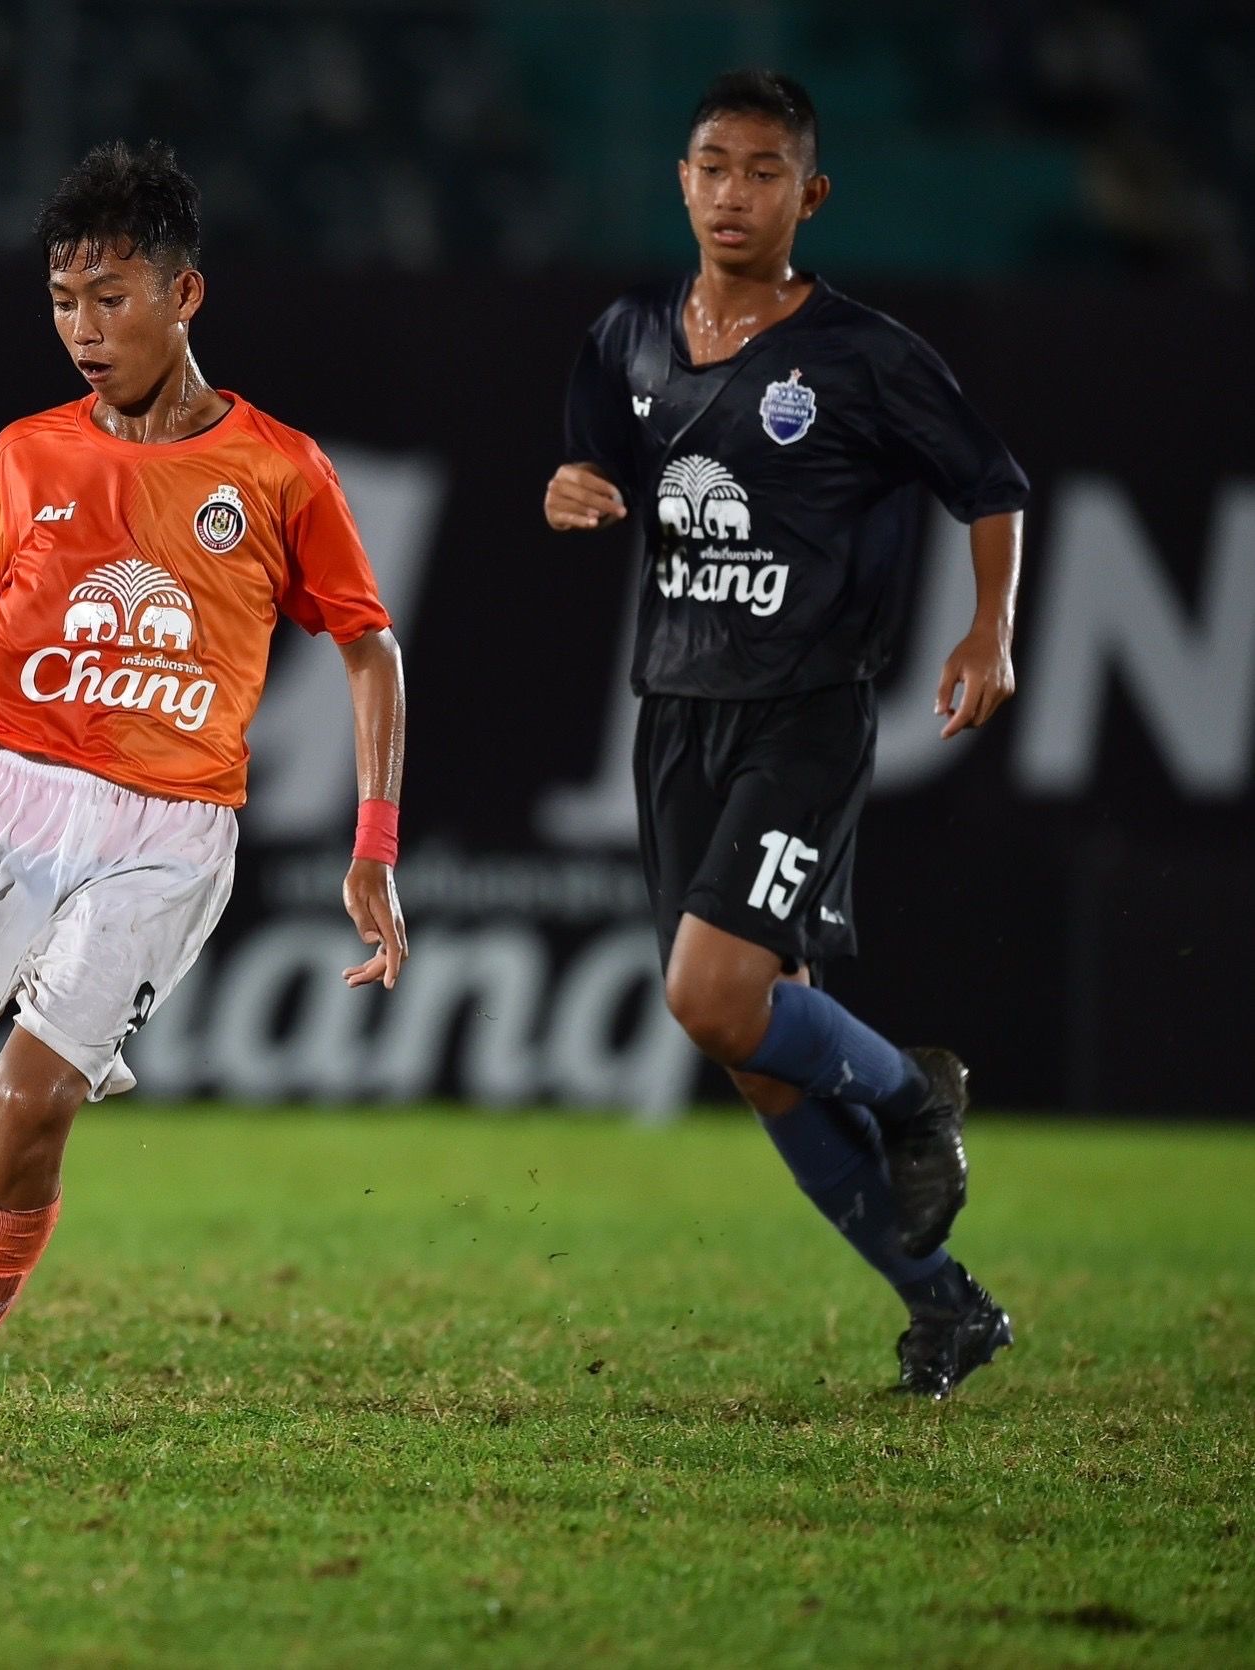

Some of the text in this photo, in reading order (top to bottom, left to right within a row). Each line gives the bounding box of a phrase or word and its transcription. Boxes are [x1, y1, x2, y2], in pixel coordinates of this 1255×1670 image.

[33, 501, 77, 521] Ari
[20, 646, 217, 732] Chang
[747, 829, 819, 921] 15
